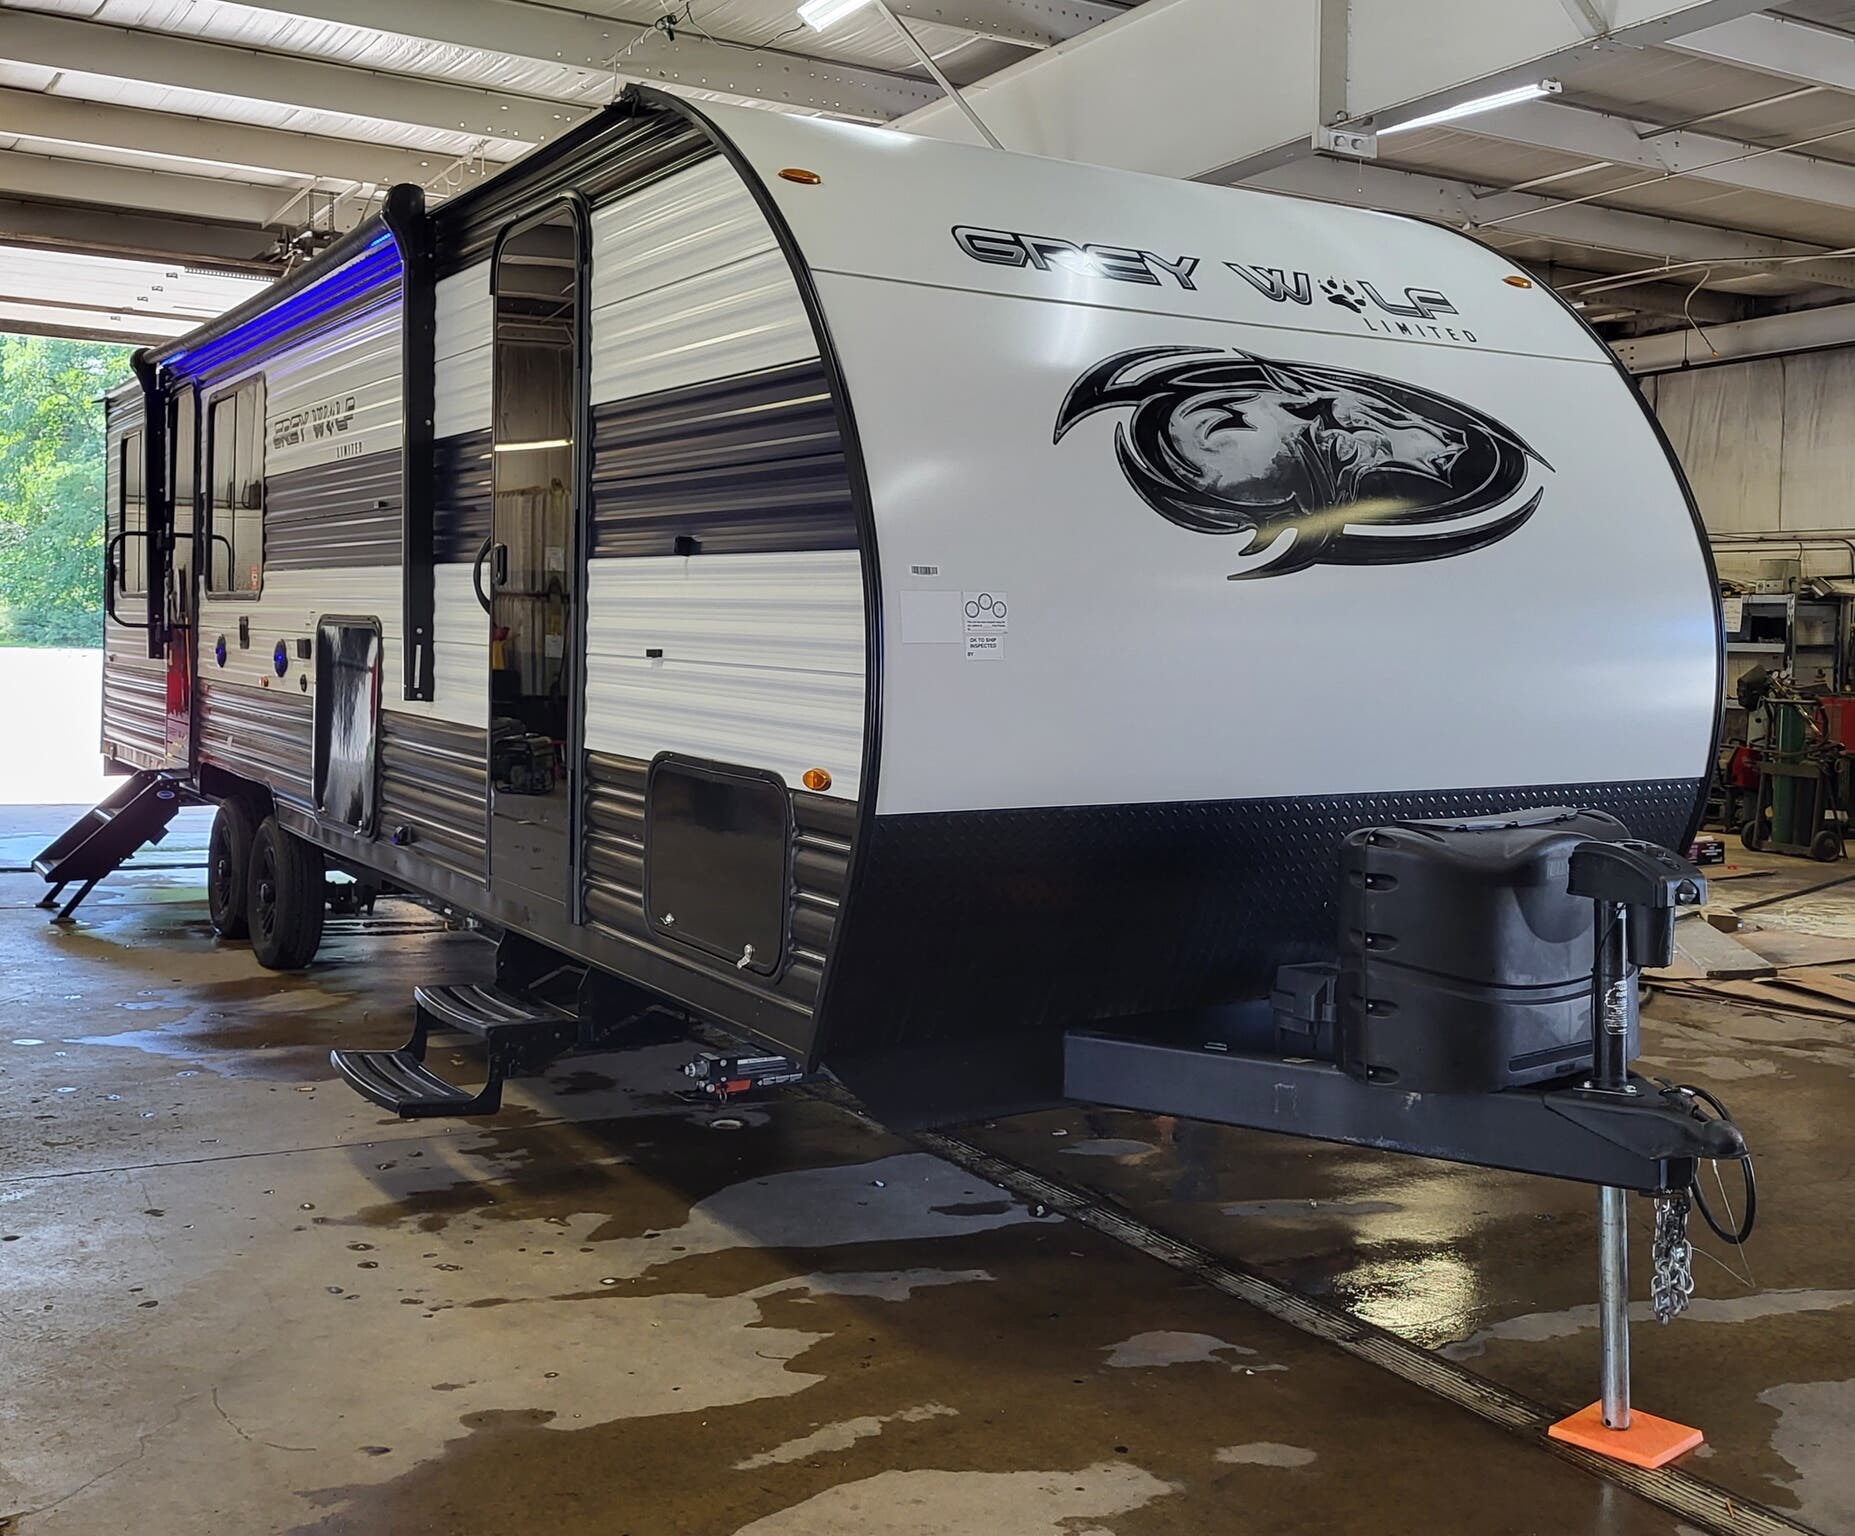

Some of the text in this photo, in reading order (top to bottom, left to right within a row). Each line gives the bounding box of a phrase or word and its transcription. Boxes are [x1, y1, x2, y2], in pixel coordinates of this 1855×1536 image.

[951, 225, 1200, 290] GREY
[1363, 317, 1477, 343] LIMITED
[336, 441, 362, 458] LIMITED
